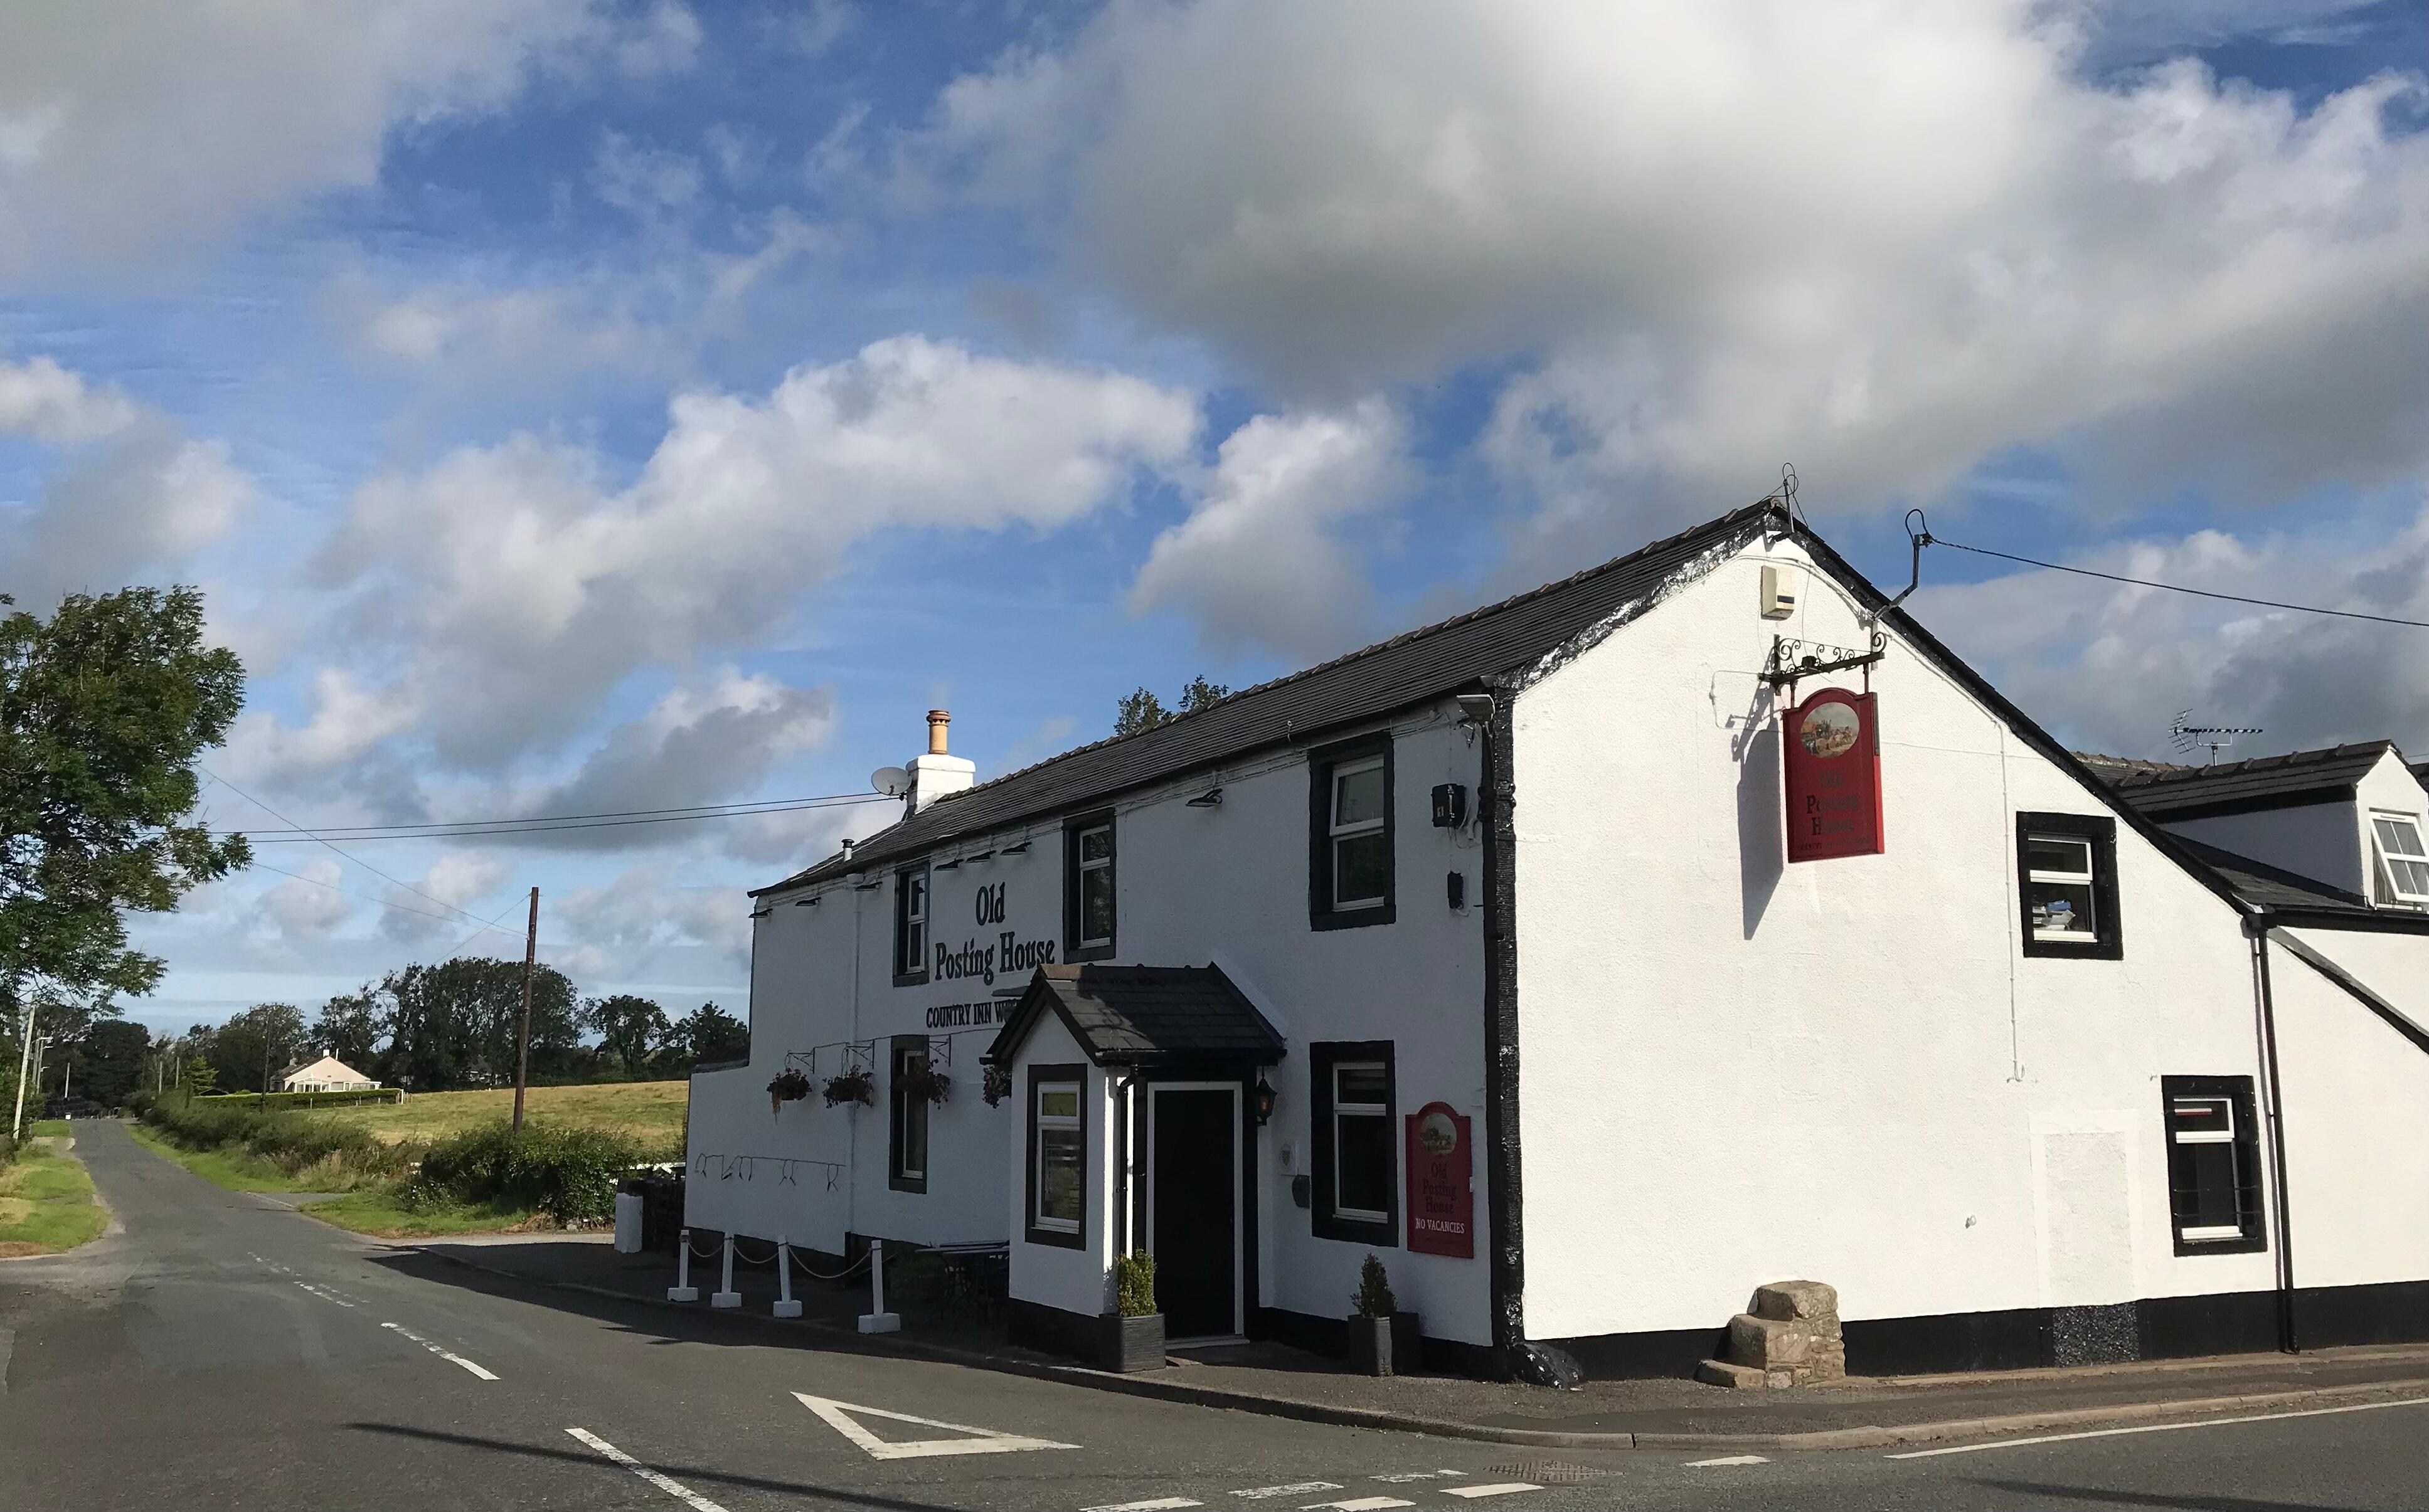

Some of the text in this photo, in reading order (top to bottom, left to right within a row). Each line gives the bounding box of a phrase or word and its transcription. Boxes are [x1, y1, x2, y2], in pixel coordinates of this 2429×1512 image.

[975, 882, 1005, 926] Old
[935, 931, 1055, 986] Posting House
[926, 1003, 972, 1028] COUNTRY
[973, 1001, 992, 1025] INN
[1431, 1163, 1447, 1178] Old
[1423, 1180, 1457, 1201] Posting
[1426, 1195, 1454, 1213] House
[1415, 1218, 1465, 1234] NO VACANCIES
